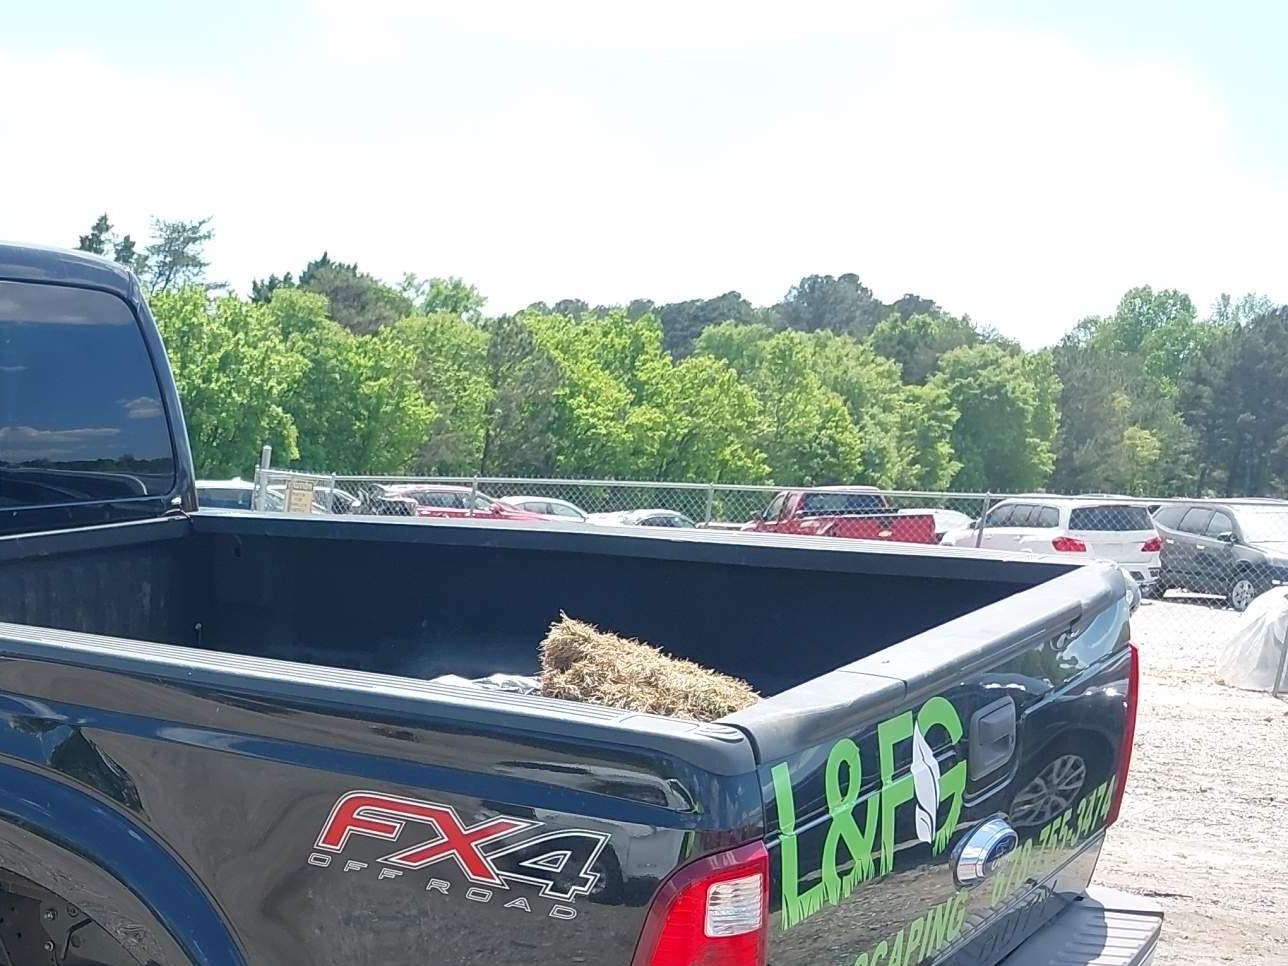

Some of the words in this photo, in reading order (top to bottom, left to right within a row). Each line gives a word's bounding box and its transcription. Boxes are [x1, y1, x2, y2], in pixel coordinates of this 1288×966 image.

[313, 790, 612, 902] FX4
[771, 697, 967, 931] L&FG
[307, 852, 404, 880] OFF
[425, 877, 578, 921] ROAD
